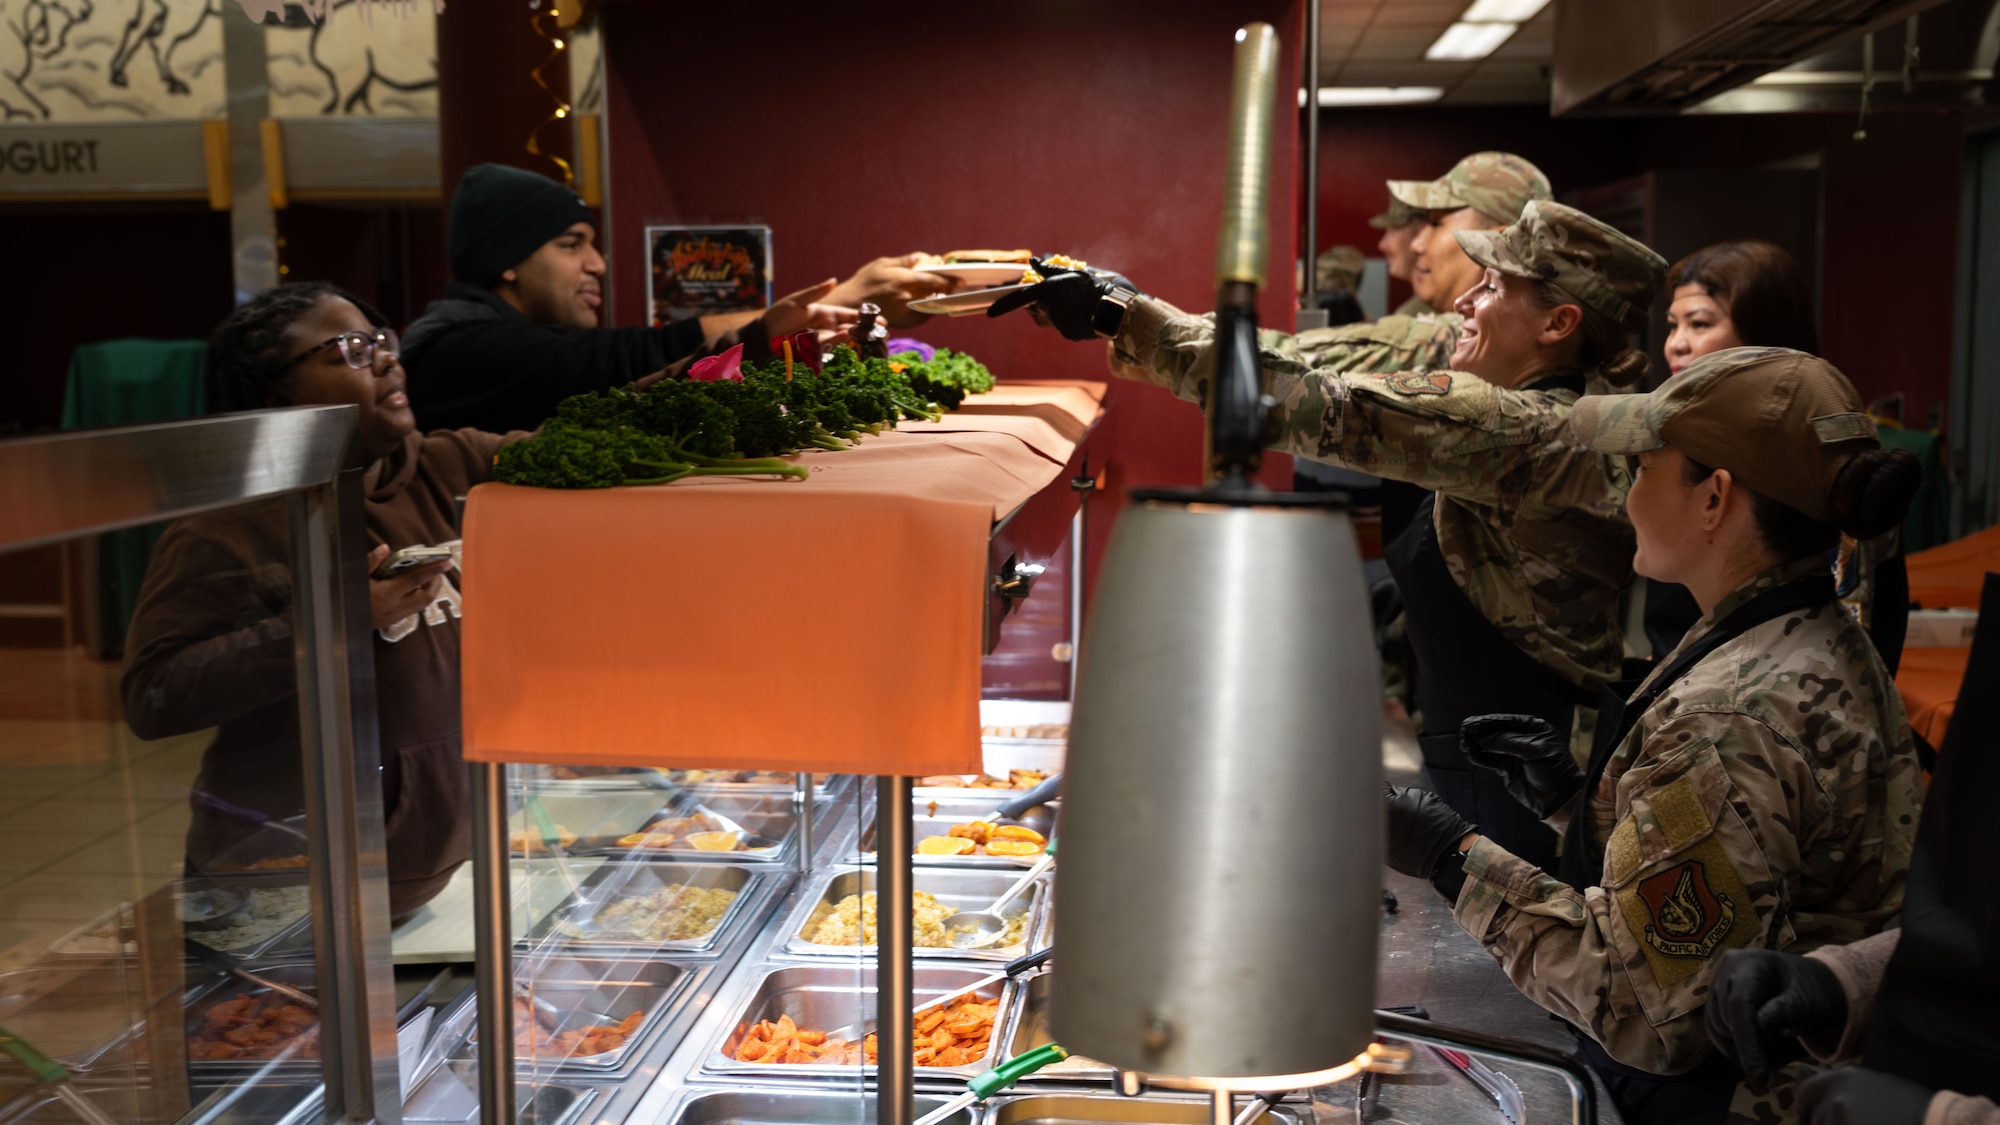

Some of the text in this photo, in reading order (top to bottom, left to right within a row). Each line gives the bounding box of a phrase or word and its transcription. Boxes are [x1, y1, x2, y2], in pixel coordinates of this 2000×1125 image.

[0, 139, 98, 175] GURT
[1660, 915, 1731, 954] PACIFIC AIR FORCES
